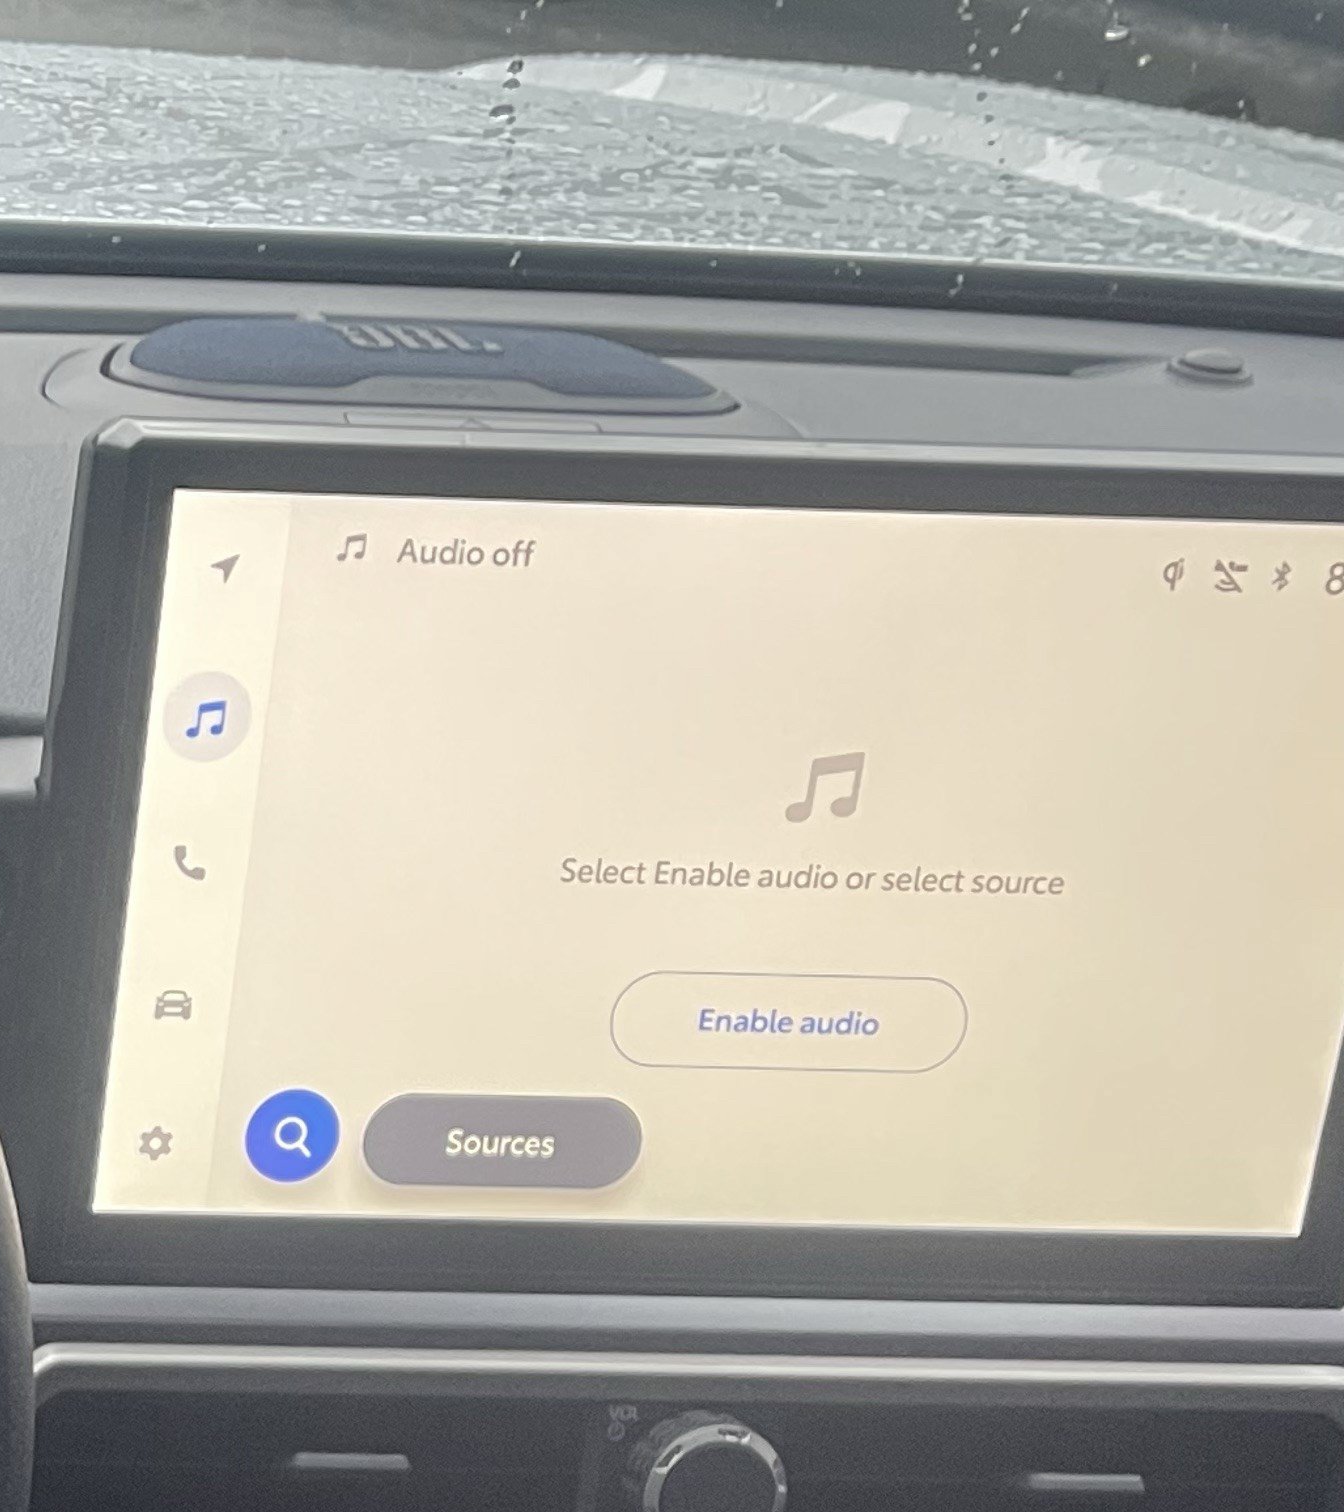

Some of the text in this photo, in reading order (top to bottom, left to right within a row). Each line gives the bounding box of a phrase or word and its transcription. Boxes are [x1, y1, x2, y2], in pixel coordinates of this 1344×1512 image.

[396, 538, 537, 568] Audio off
[560, 858, 1065, 896] Select Enable audio or select source
[698, 1009, 881, 1036] Enable audio
[446, 1128, 556, 1157] Sources
